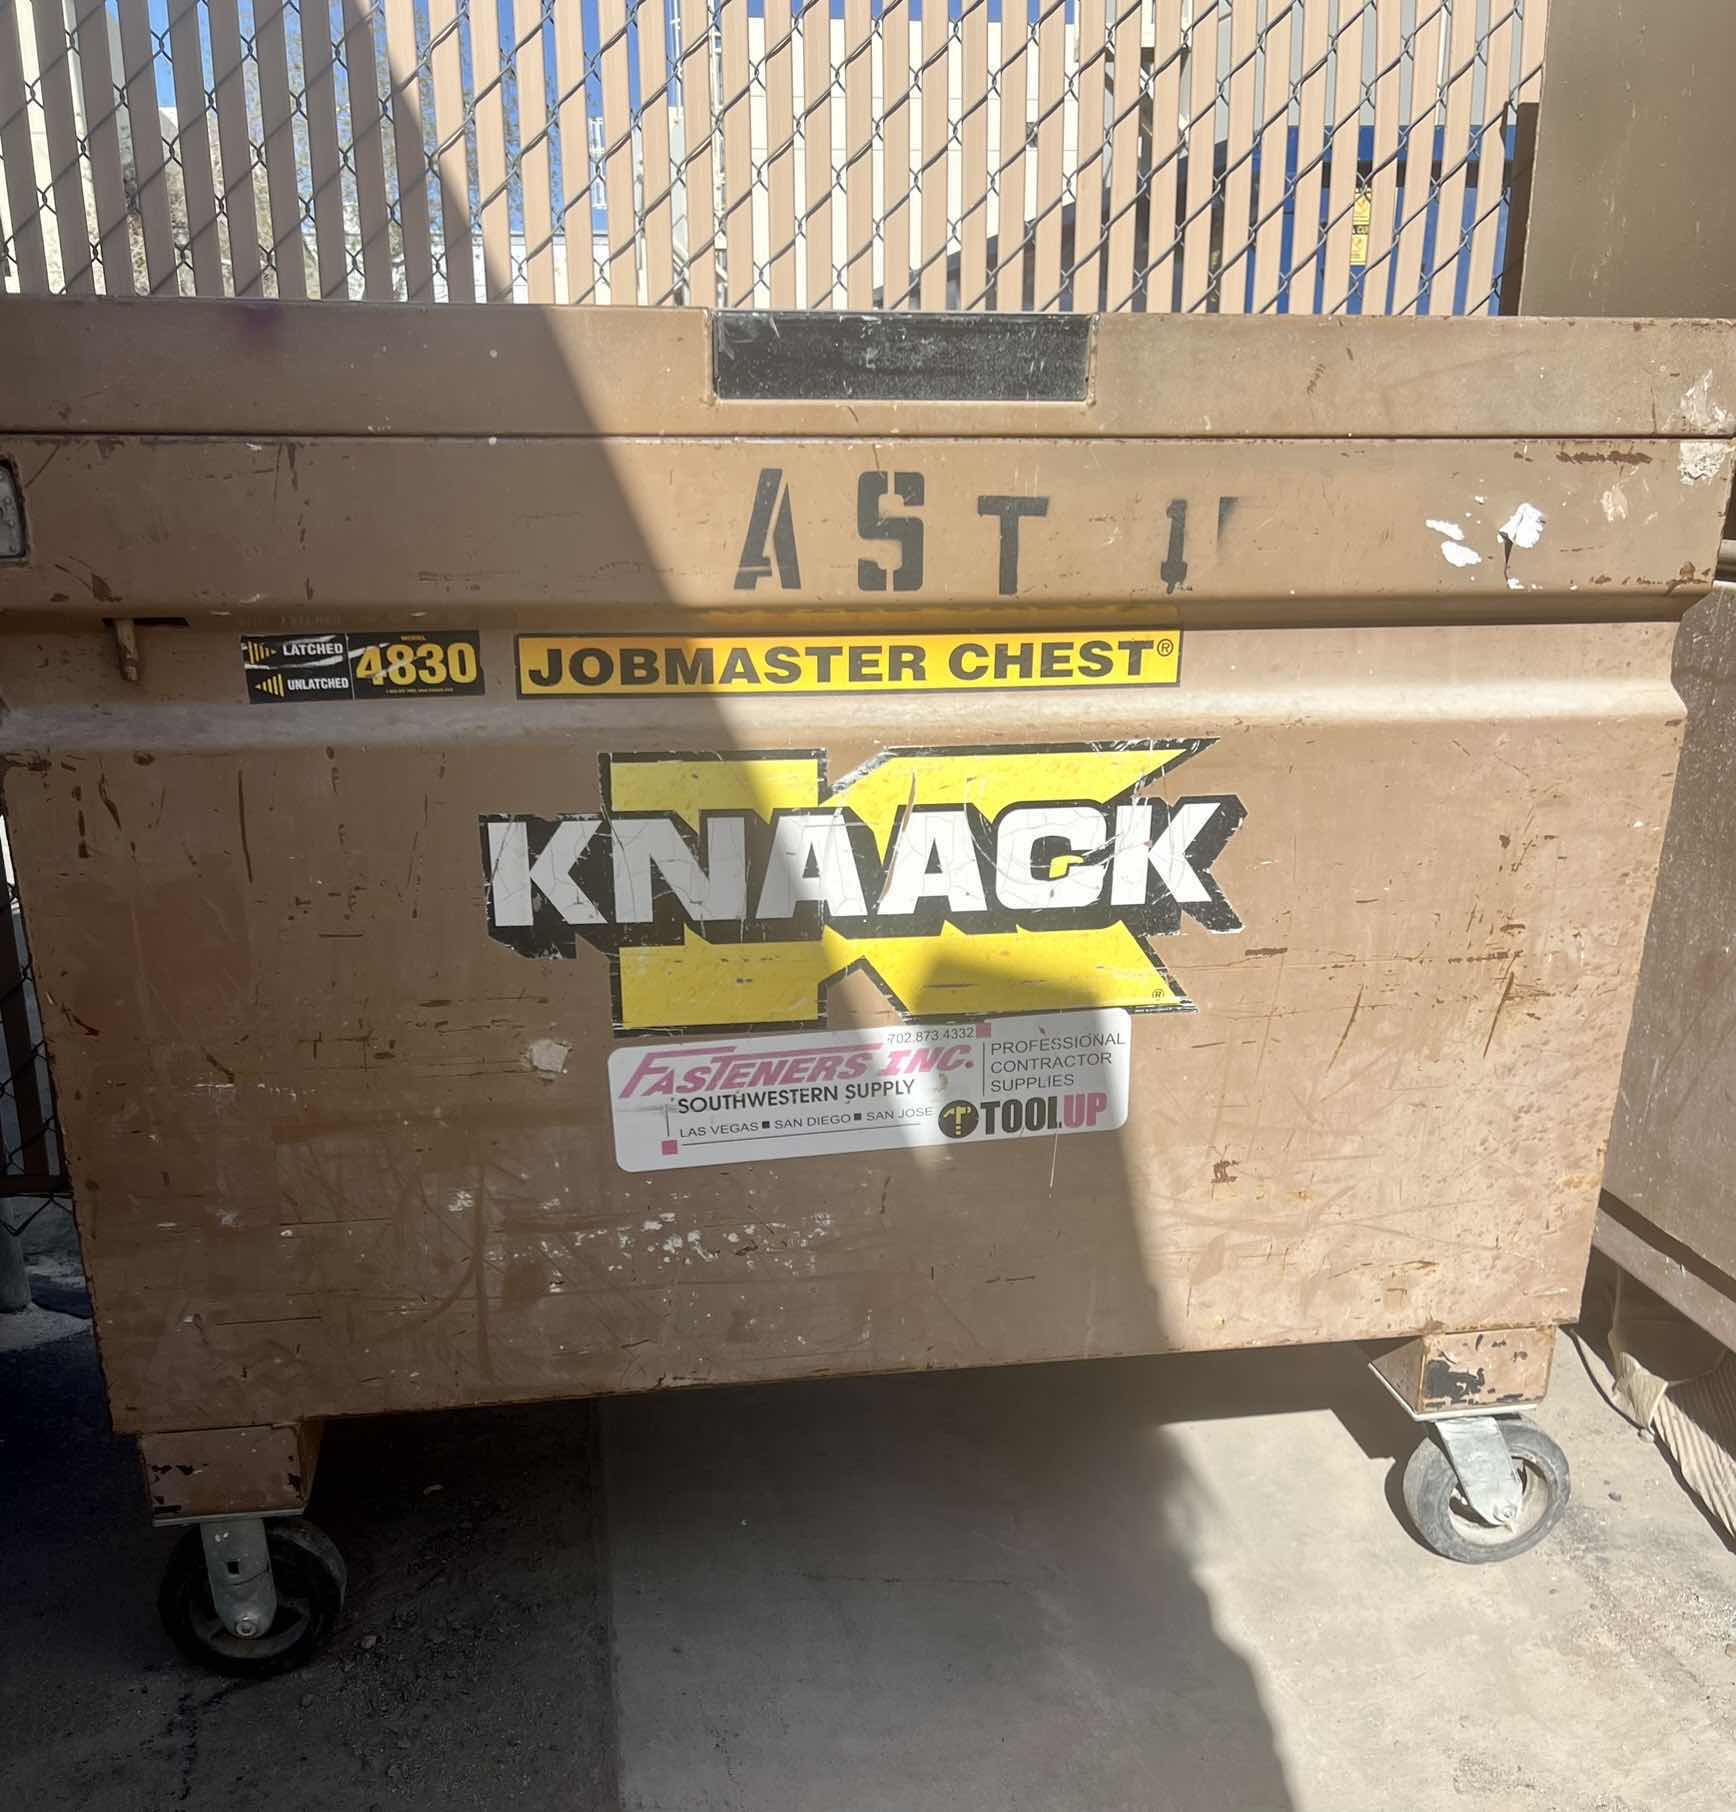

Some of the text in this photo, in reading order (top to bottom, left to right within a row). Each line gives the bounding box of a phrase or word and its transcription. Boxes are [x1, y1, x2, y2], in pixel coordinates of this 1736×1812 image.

[282, 642, 344, 656] LATCHED
[355, 642, 478, 686] 4830
[528, 643, 928, 688] JOBMASTER
[287, 677, 349, 691] UNLATCHED
[487, 801, 1222, 927] KNAACK
[991, 1032, 1126, 1056] PROFESSIONAL
[990, 1051, 1112, 1074] CONTRACTOR
[677, 1079, 915, 1114] SOUTHWESTERN SUPPLY
[990, 1073, 1075, 1093] SUPPLIES
[680, 1106, 935, 1138] LAS VEGAS SAN DIEGO SAN JOSE
